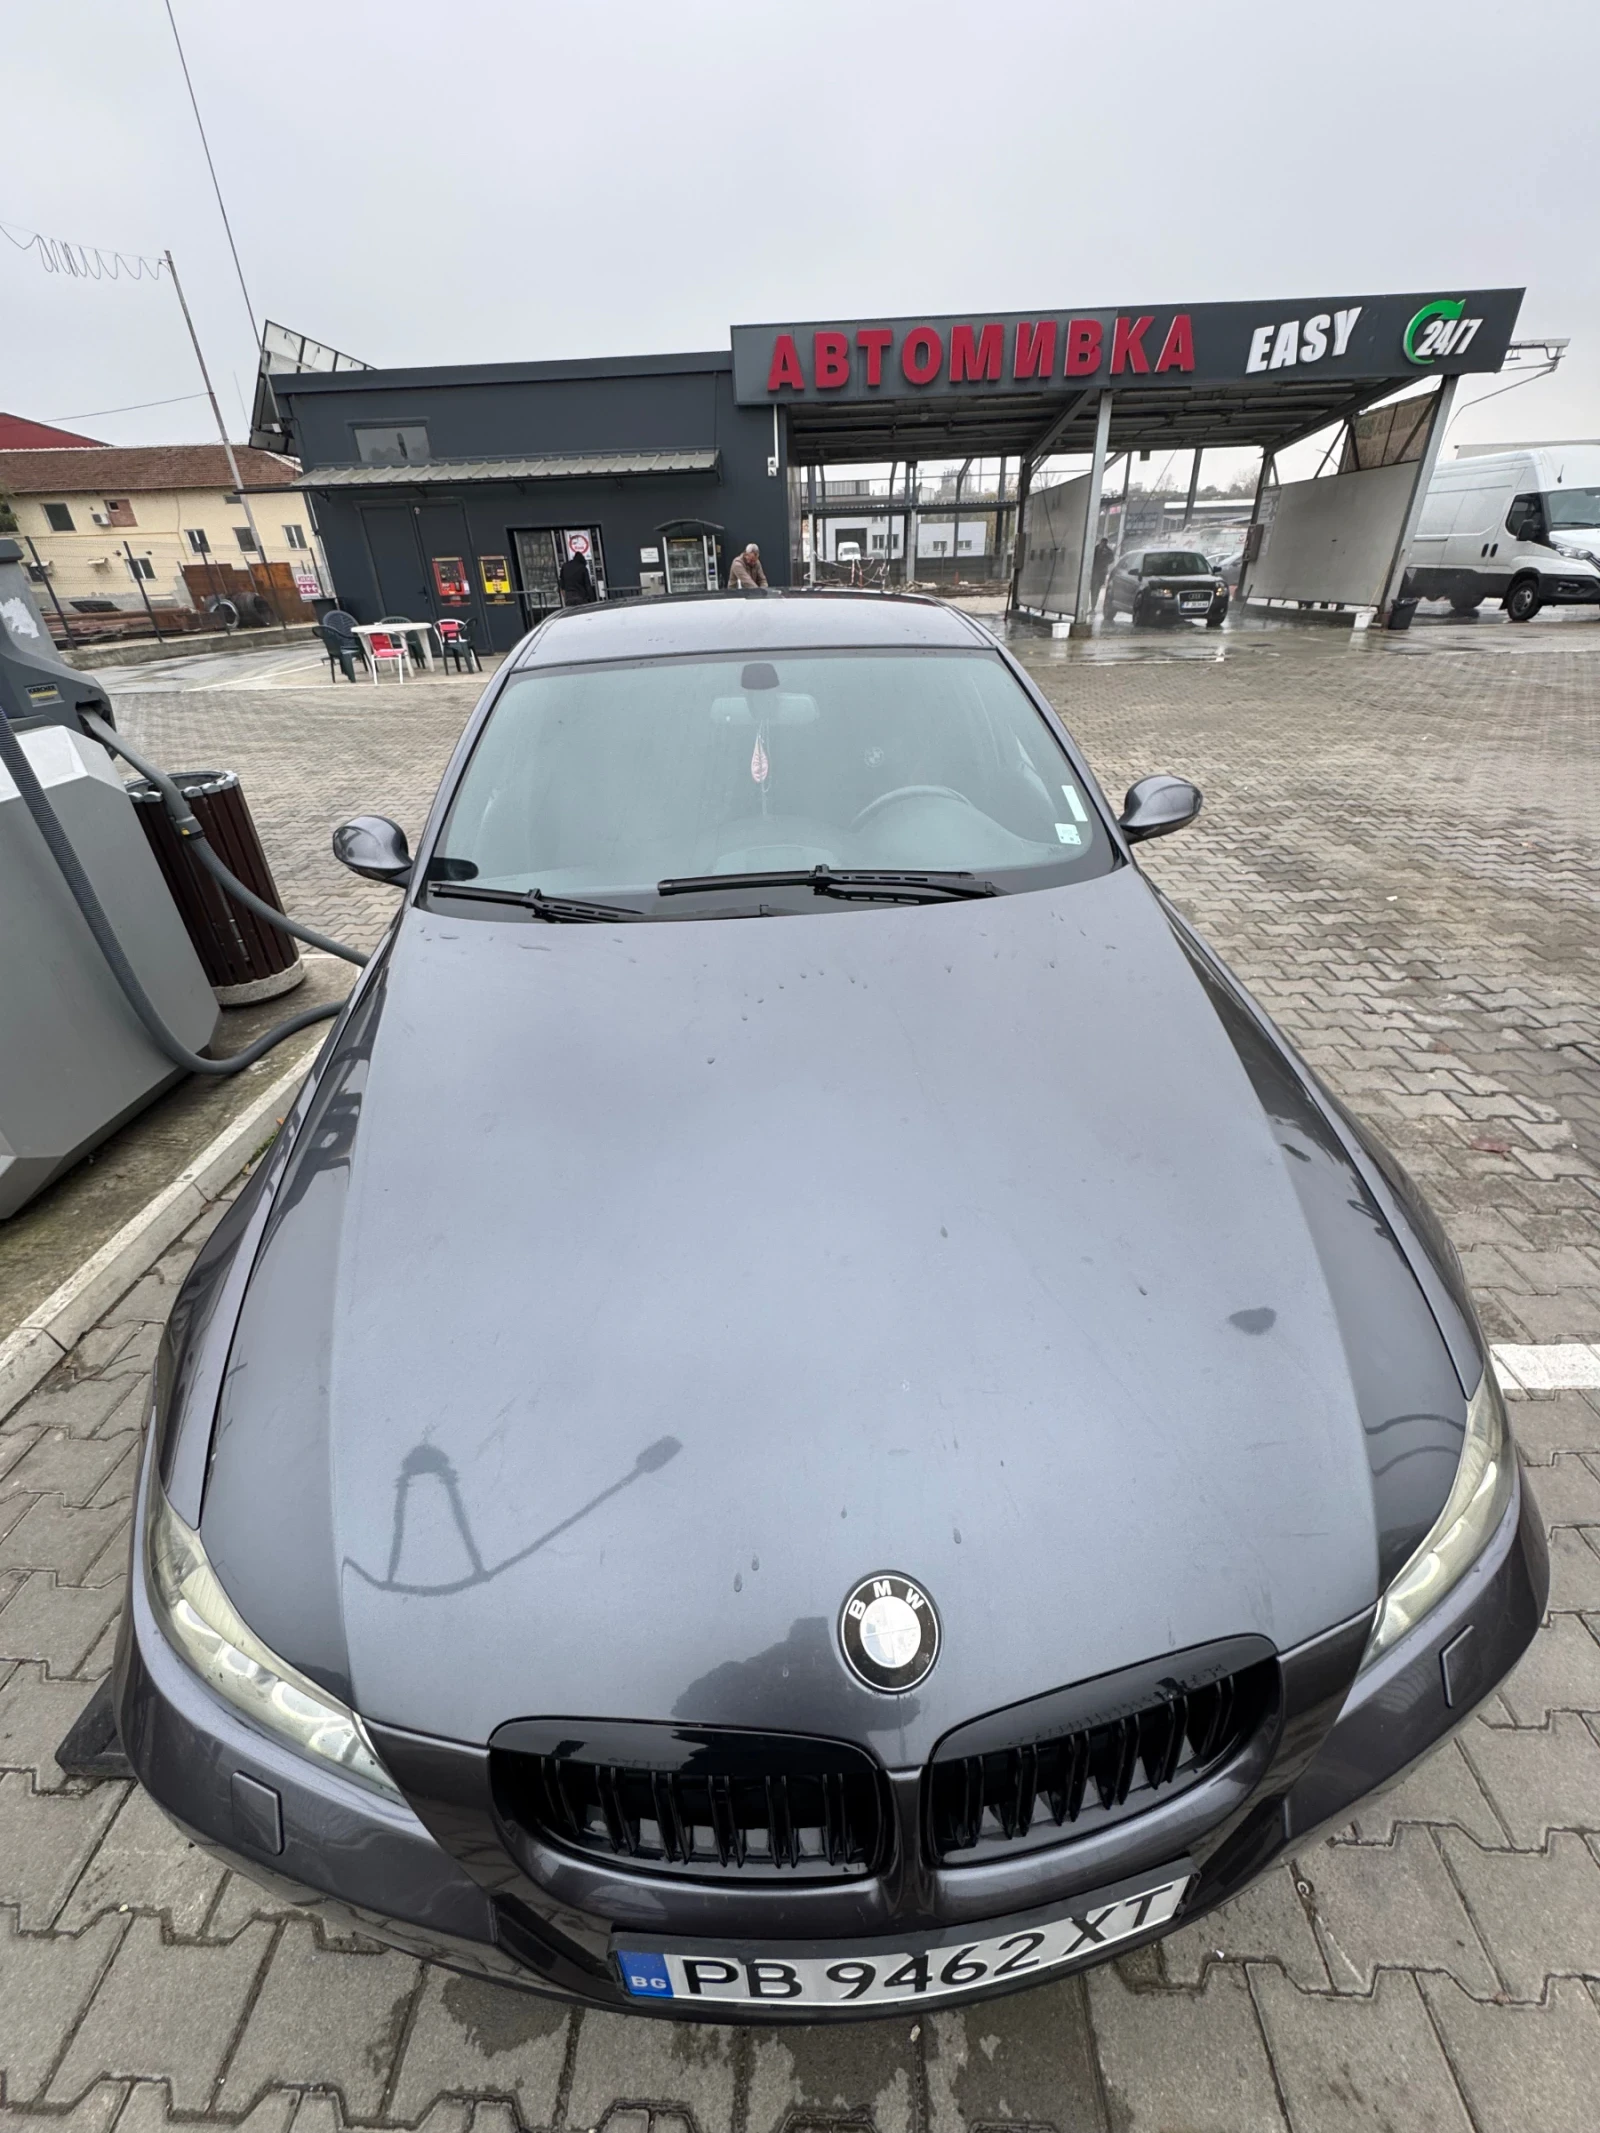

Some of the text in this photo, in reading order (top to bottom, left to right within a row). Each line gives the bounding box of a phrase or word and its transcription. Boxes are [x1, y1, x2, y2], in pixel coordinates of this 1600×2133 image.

[767, 314, 1196, 391] АВТОМИВКА
[1246, 306, 1363, 374] EASY
[1414, 318, 1484, 357] 24/7
[848, 1579, 925, 1620] BMW
[682, 1884, 1174, 2000] PB 9462 XT
[631, 1975, 668, 1989] BG
